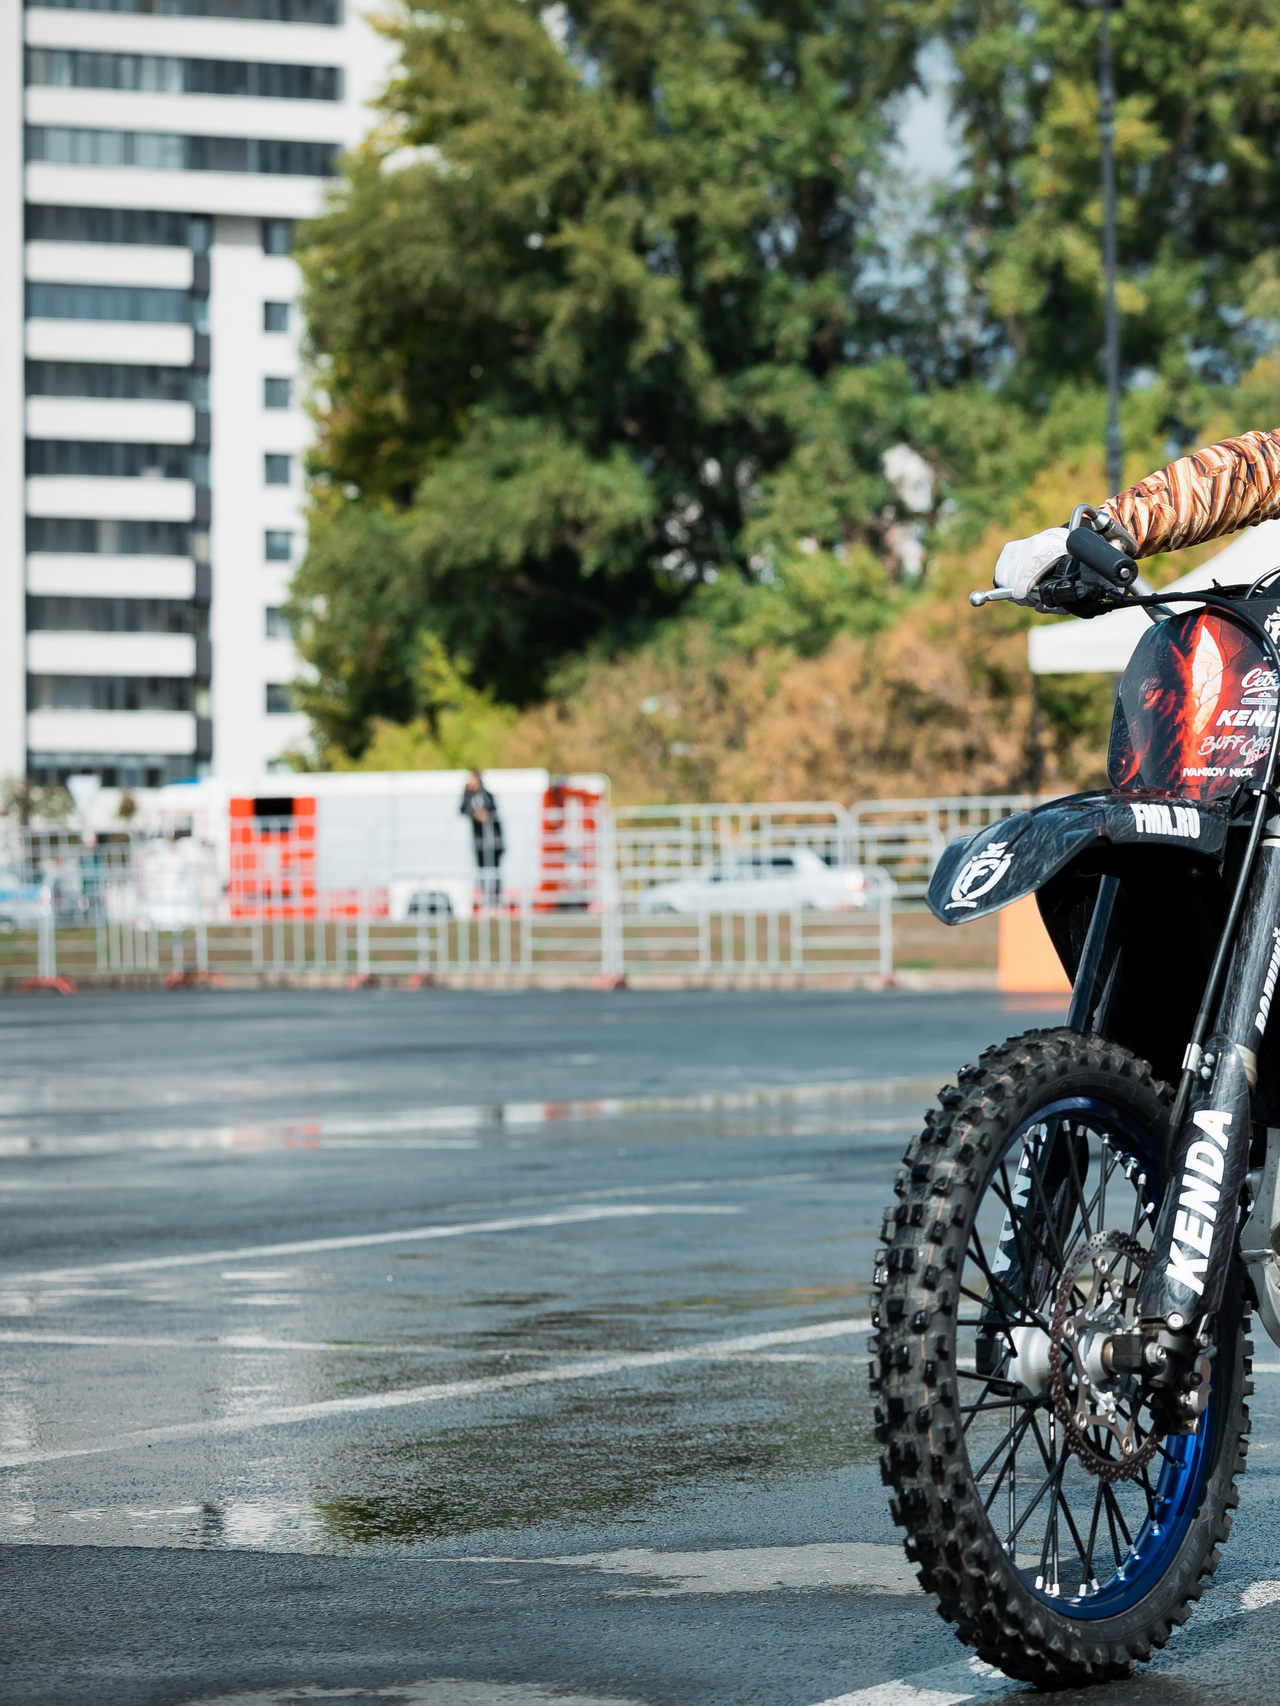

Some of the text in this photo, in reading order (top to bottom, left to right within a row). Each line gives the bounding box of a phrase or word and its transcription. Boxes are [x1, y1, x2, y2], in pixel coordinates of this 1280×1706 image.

[1197, 734, 1246, 756] BUFF
[1182, 766, 1254, 778] IVANKOV NICK
[1130, 803, 1201, 839] FMX.RU
[1165, 1109, 1233, 1296] KENDA
